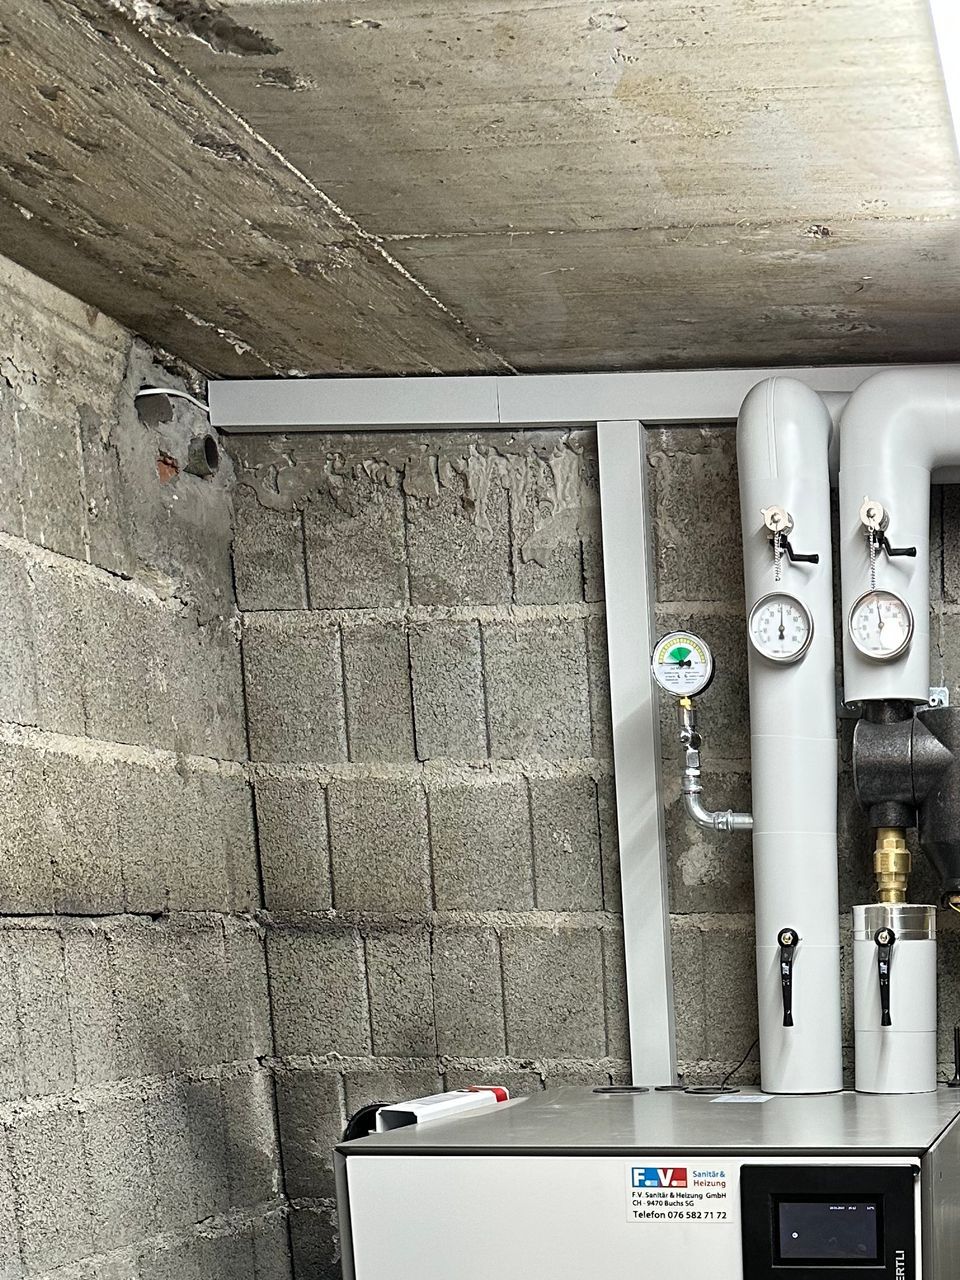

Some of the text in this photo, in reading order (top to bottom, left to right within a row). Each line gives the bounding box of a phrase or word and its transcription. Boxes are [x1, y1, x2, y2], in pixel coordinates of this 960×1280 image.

[693, 1180, 727, 1189] Heizung
[645, 1191, 669, 1199] Sanitär
[675, 1192, 704, 1200] Heizung
[632, 1199, 642, 1207] CH
[664, 1199, 684, 1207] Buchs
[633, 1210, 727, 1219] Telefon 076 582 71 72
